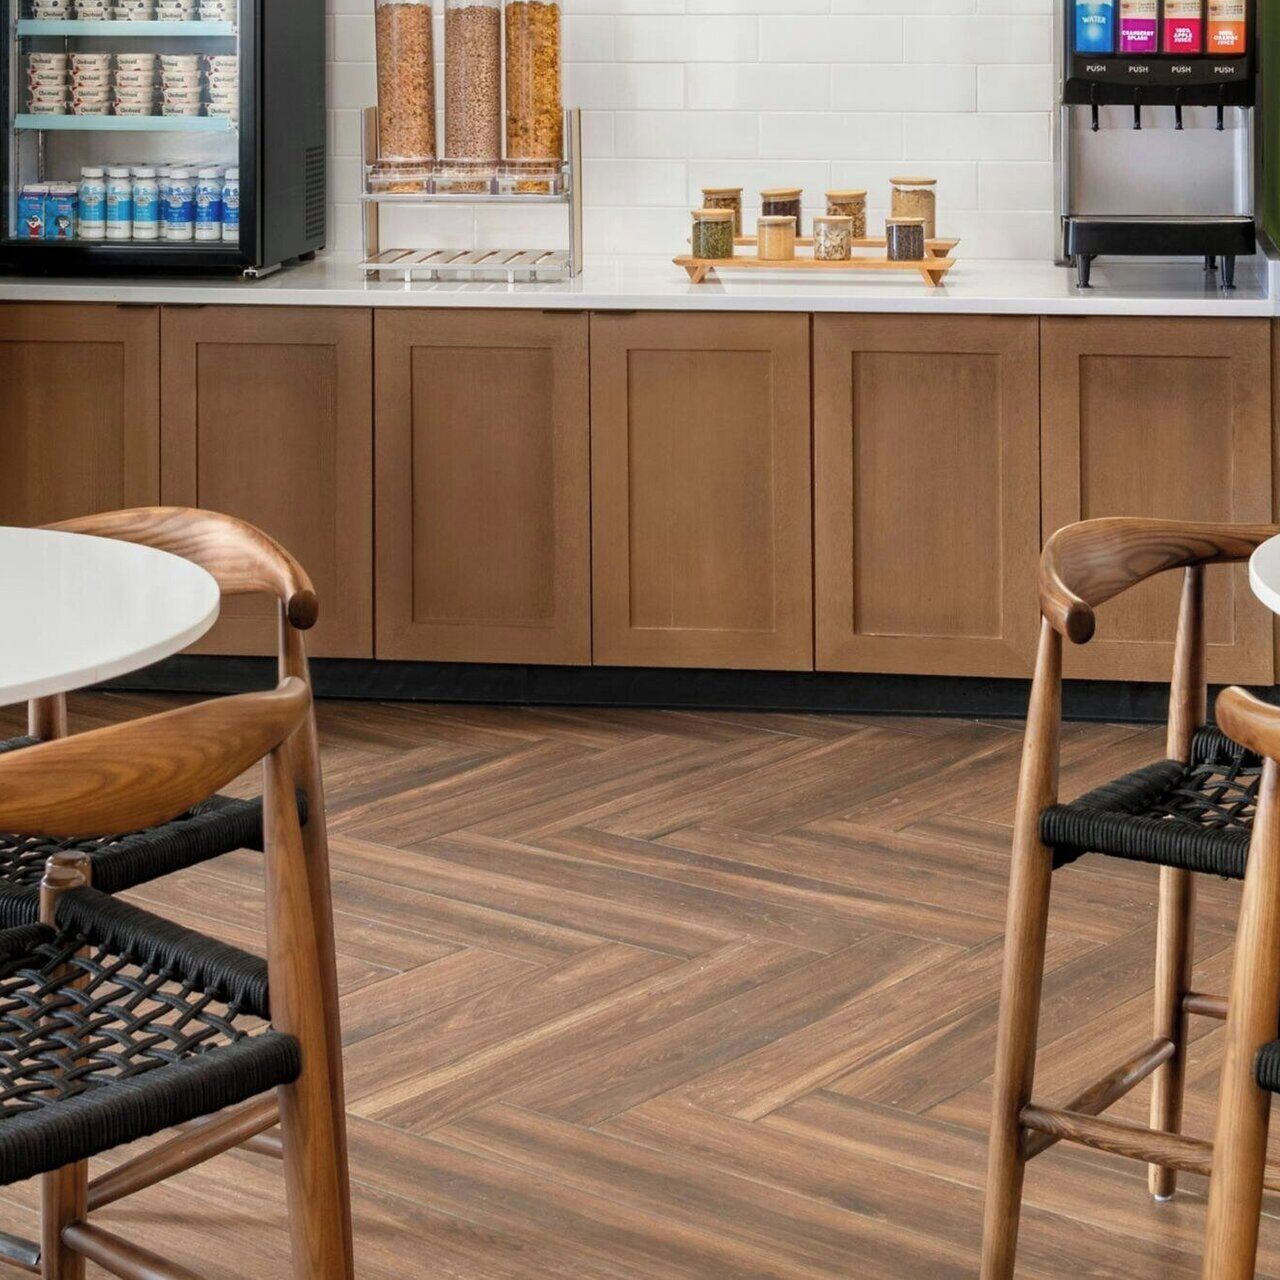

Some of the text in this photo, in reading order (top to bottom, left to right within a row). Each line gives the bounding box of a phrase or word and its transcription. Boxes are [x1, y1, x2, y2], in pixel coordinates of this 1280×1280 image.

[1082, 15, 1106, 25] WATER
[1128, 65, 1149, 73] PUSH
[1171, 65, 1192, 73] PUSH
[1214, 66, 1235, 74] PUSH
